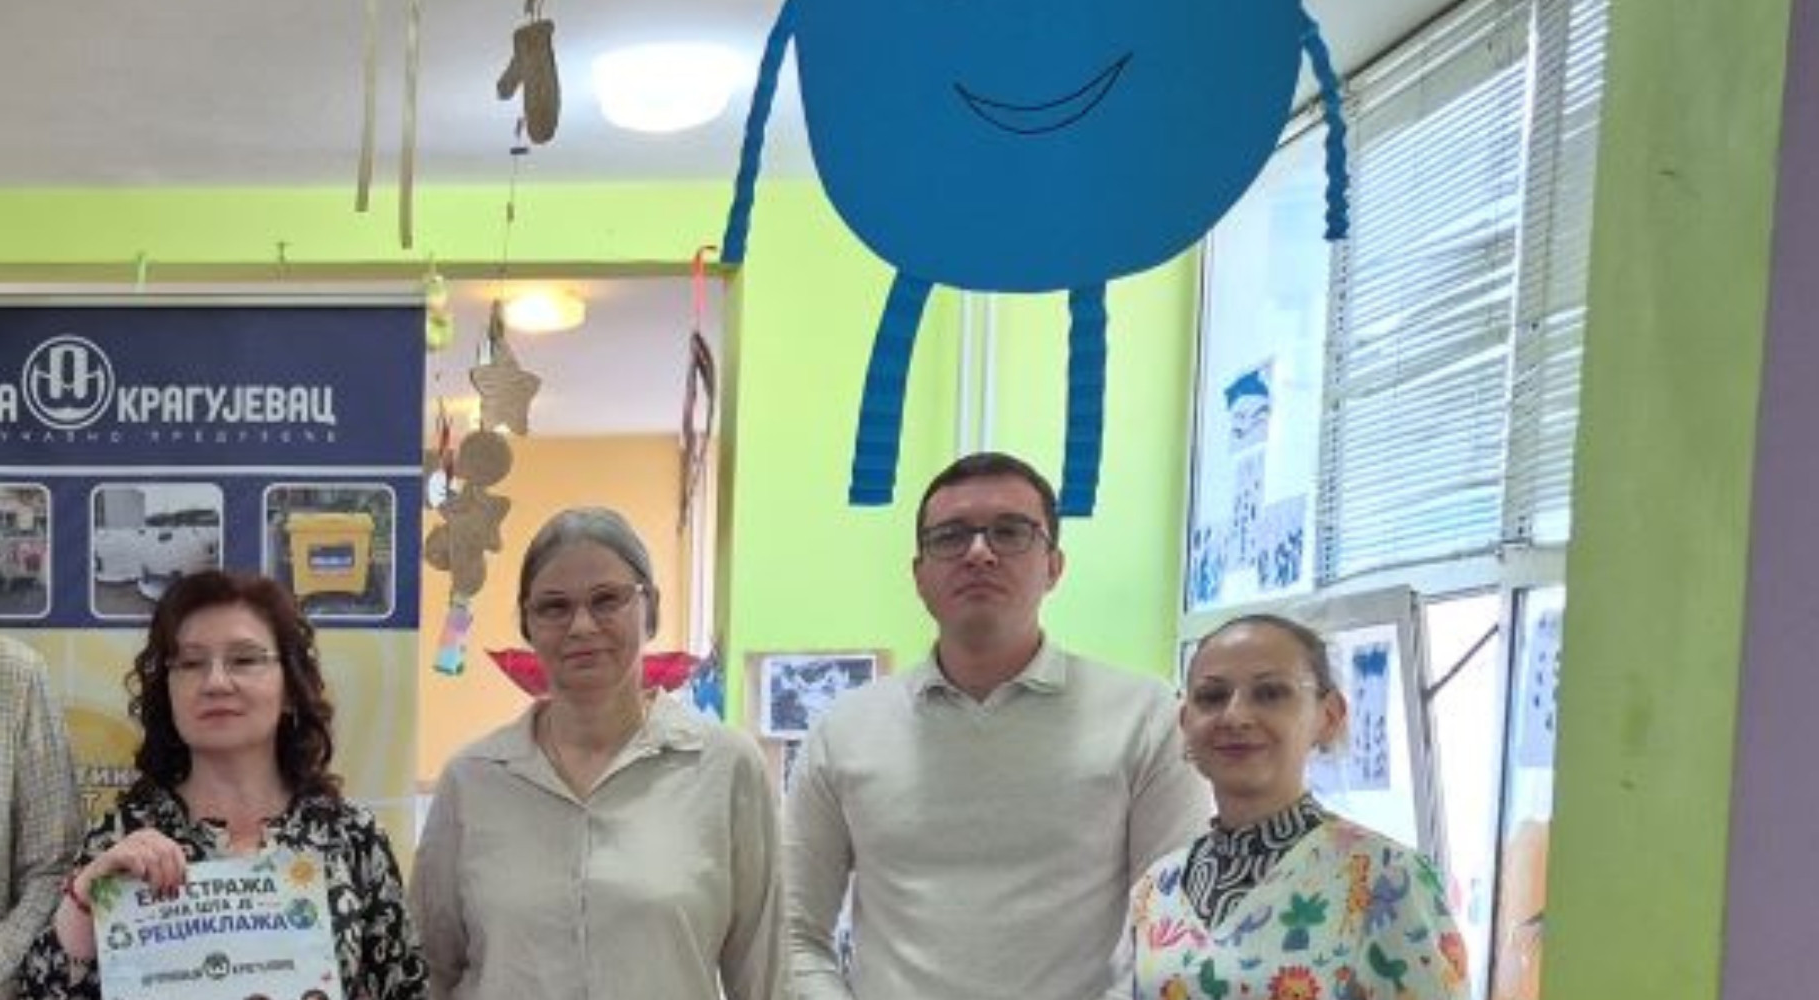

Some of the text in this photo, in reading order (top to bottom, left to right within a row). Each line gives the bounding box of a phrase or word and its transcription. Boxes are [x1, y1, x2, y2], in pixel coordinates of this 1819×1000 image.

[117, 386, 336, 425] КРАГУЈЕВАЦ
[185, 877, 277, 900] СТРАЖА
[137, 914, 288, 946] РЕЦИКЛАЖА
